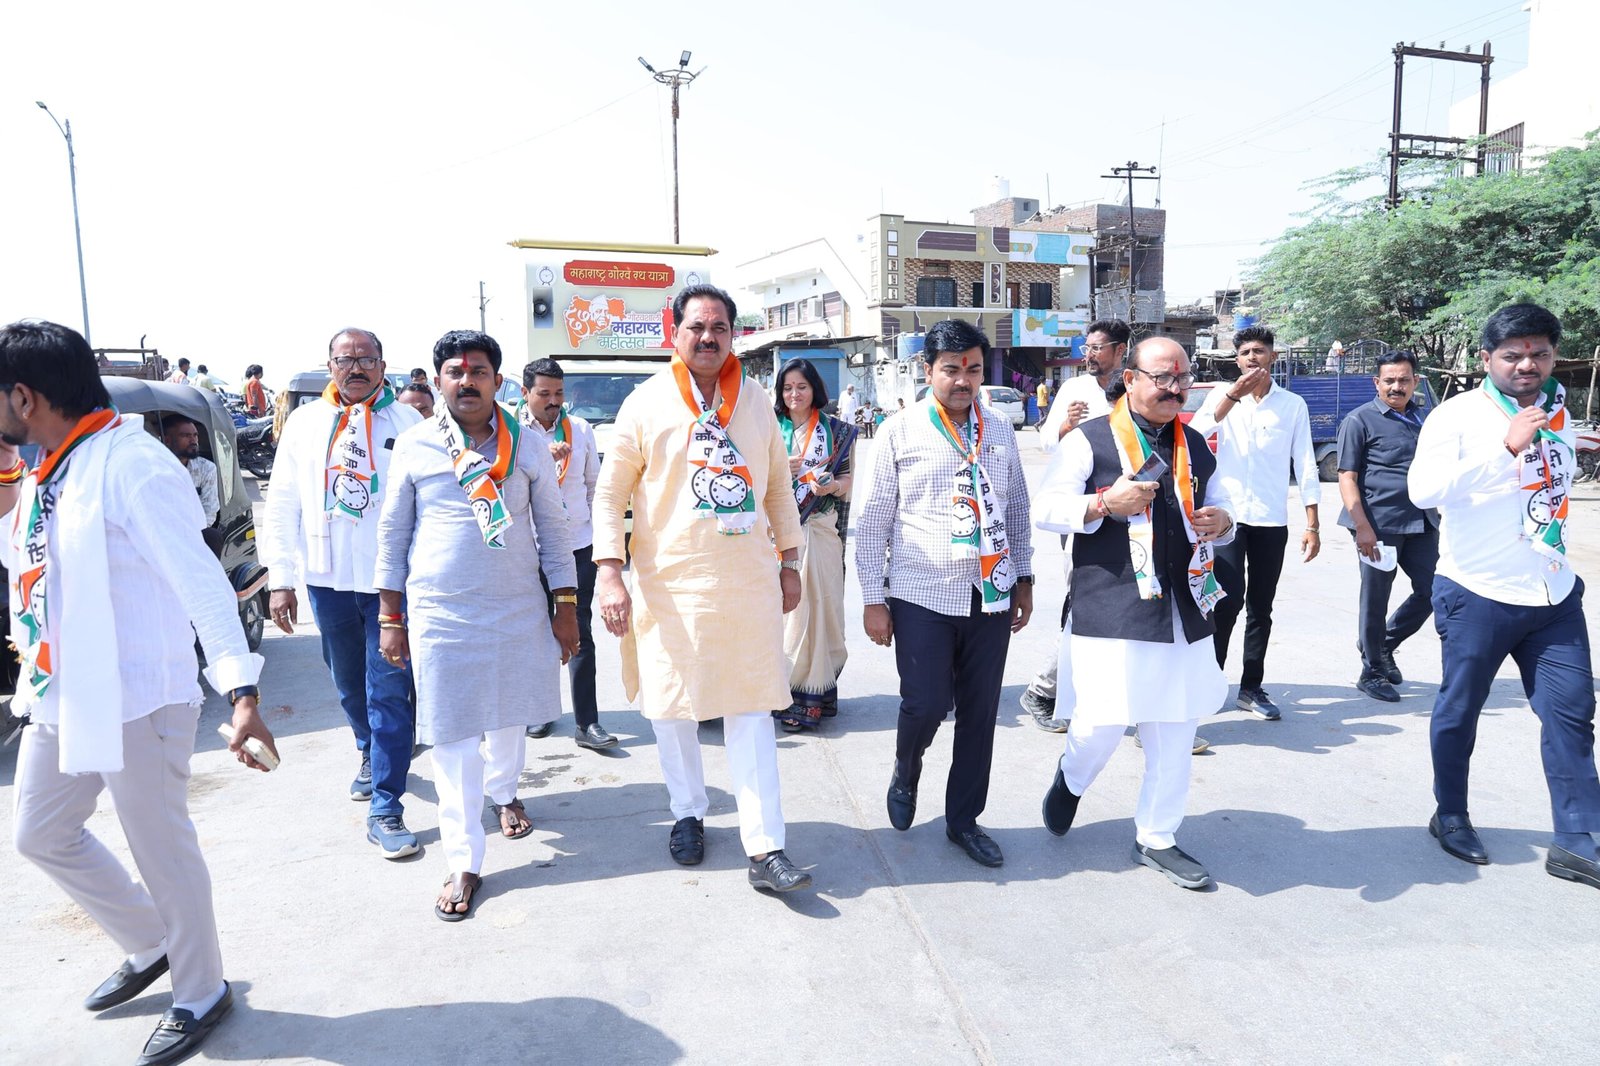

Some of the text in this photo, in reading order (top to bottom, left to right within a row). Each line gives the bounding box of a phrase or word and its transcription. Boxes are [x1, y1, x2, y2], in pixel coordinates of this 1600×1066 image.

[569, 267, 606, 283] महाराष्ट्र
[632, 270, 646, 281] रथ
[648, 271, 669, 282] यात्रा
[611, 321, 662, 336] महाराष्ट्र
[598, 333, 645, 350] महोत्सव
